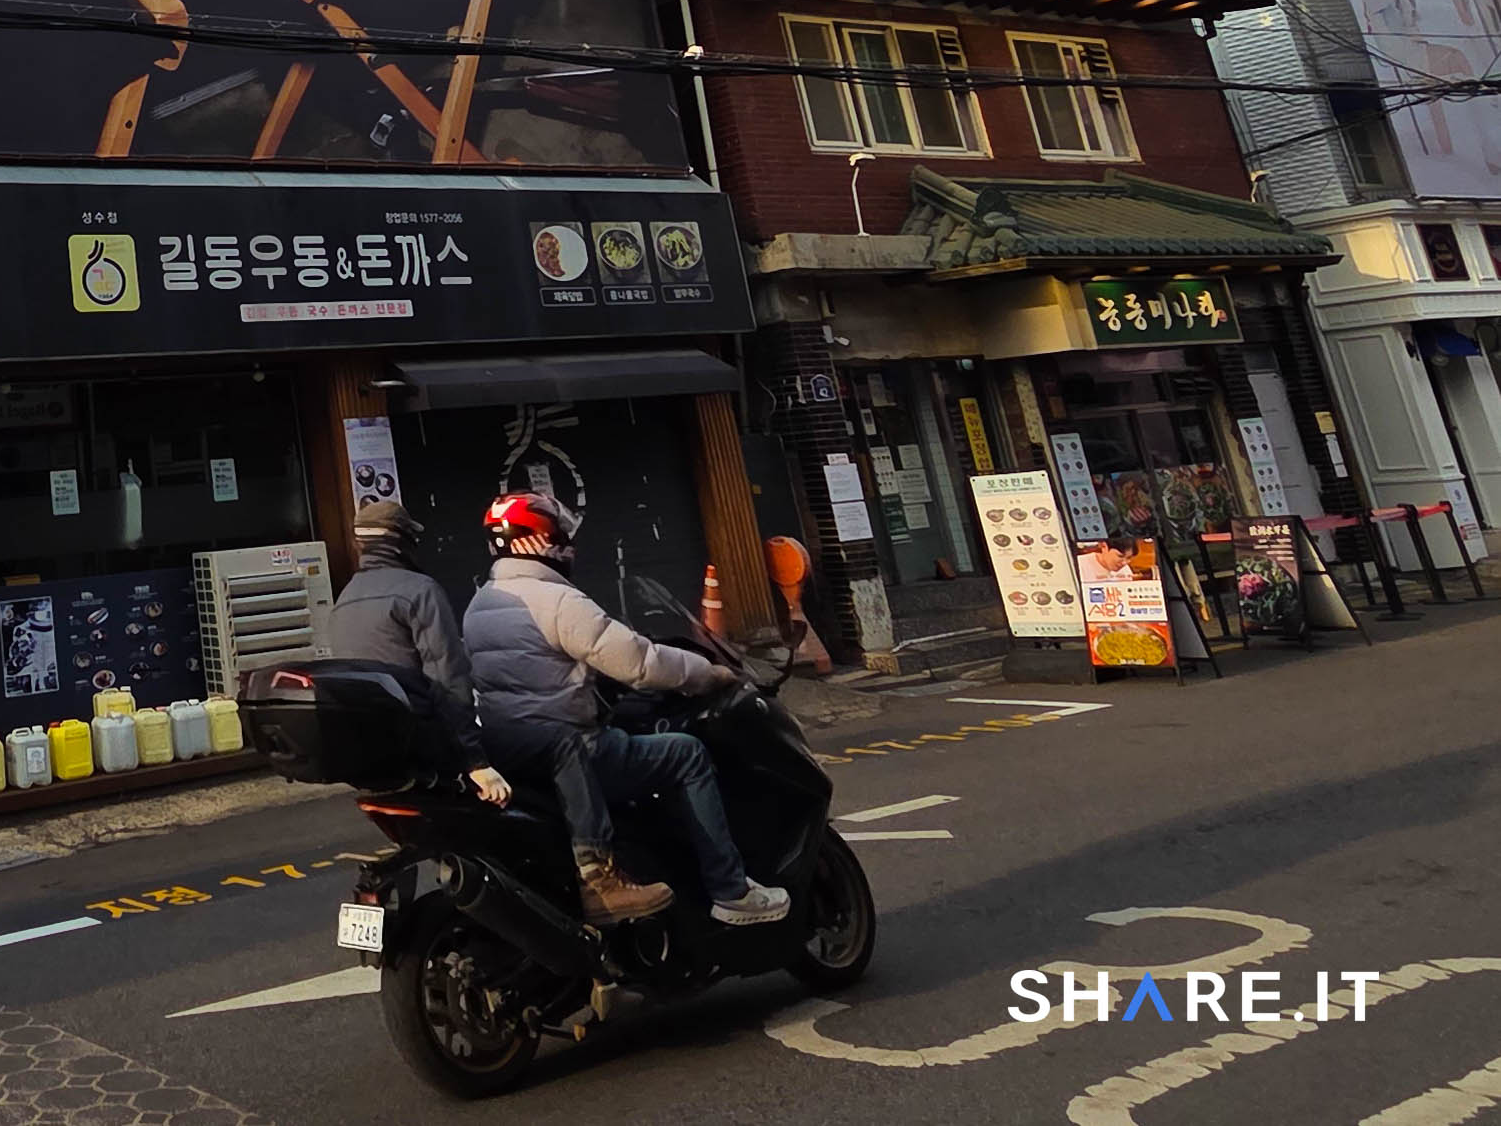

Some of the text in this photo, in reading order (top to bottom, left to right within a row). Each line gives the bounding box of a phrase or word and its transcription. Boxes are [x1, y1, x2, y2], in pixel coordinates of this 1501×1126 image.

[81, 211, 118, 224] 성수점
[306, 305, 328, 317] 국수
[337, 304, 370, 316] 돈까스
[86, 885, 214, 919] 지정
[351, 923, 378, 944] 7248
